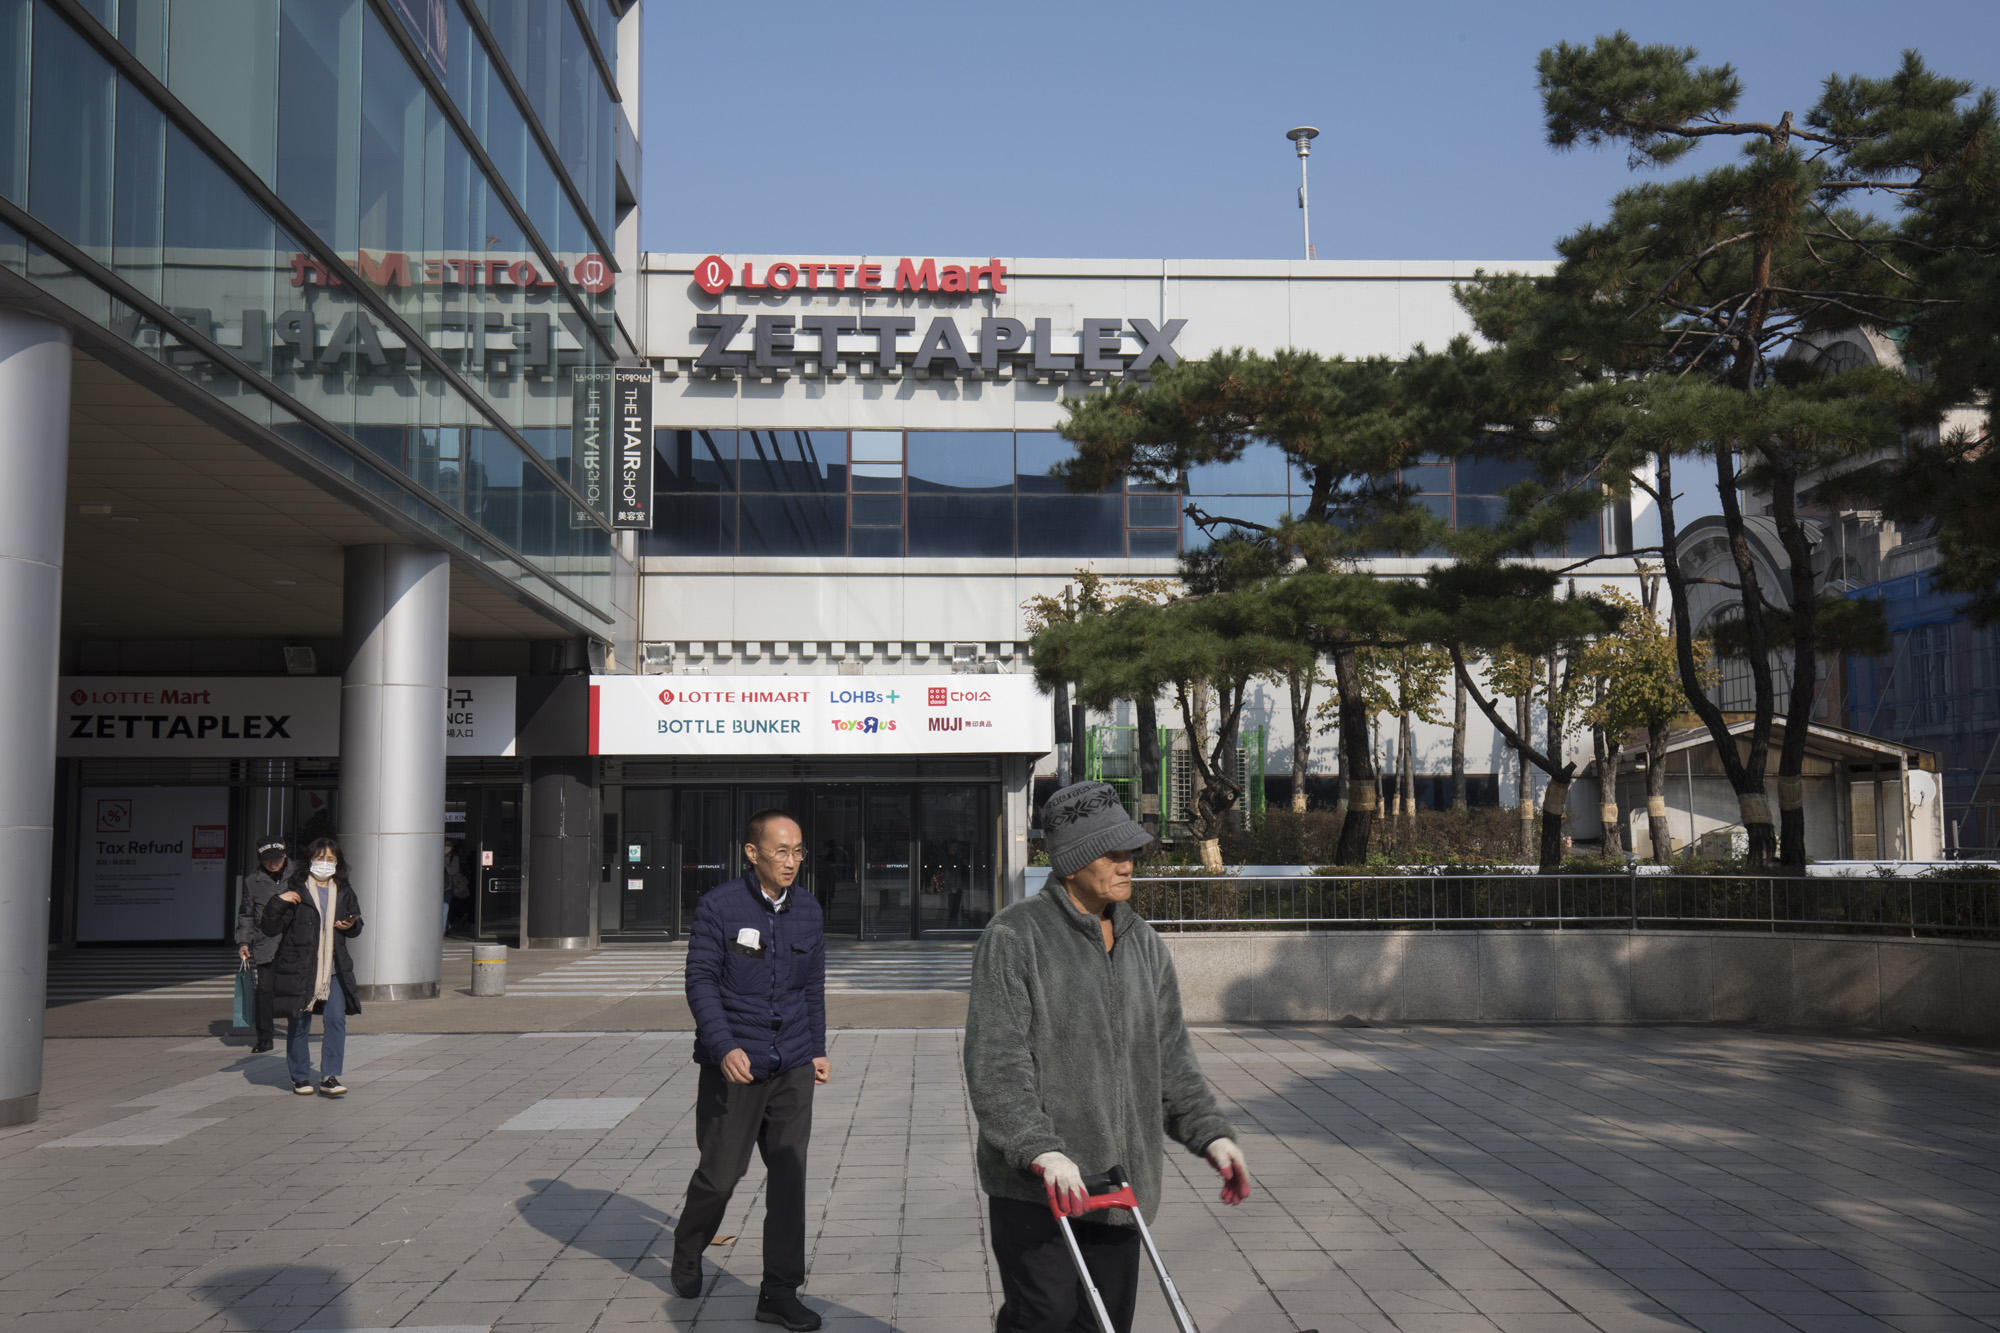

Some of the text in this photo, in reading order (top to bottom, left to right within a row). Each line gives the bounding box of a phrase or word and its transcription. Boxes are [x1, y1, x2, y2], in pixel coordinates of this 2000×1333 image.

[744, 258, 1008, 294] LOTTE Mart
[695, 313, 1188, 372] ZETTAPLEX
[623, 388, 642, 506] THE HAIR SHOP
[617, 511, 646, 521] 美容室
[92, 690, 211, 705] LOTTE Mart
[679, 691, 811, 703] LOTTE HIMART
[951, 691, 991, 702] 다이소
[70, 714, 292, 739] ZETTAPLEX
[658, 719, 801, 734] BOTTLE BUNKER
[928, 717, 963, 732] MUJI
[965, 720, 993, 728] 無印良品
[96, 841, 125, 854] Tax
[128, 840, 183, 854] Refund
